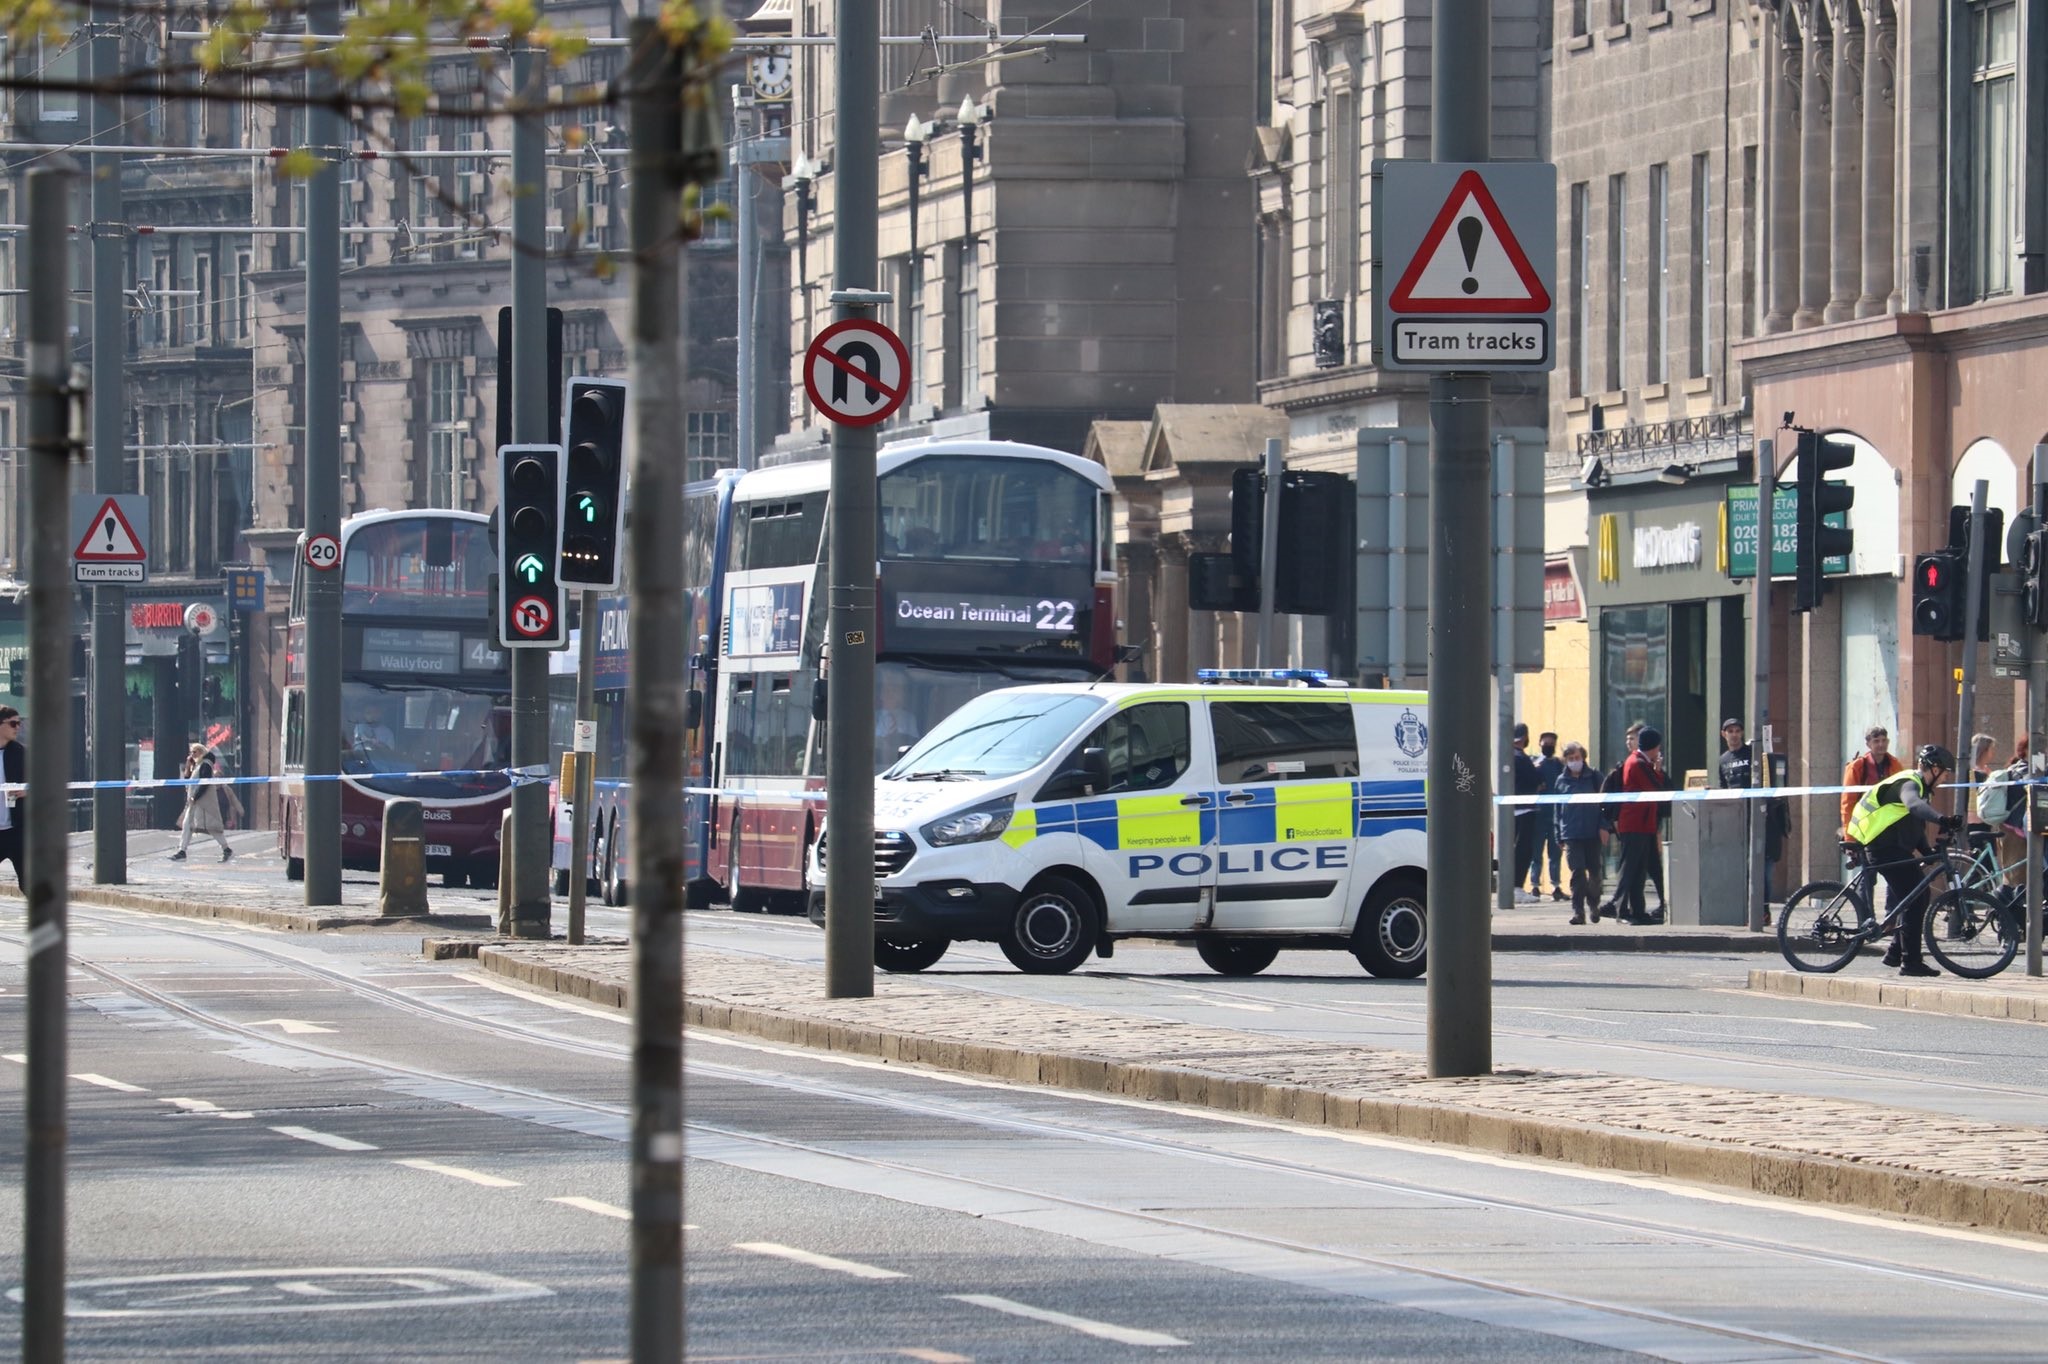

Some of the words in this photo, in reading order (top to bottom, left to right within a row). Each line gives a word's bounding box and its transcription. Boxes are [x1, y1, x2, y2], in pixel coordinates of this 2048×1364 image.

[1404, 331, 1460, 350] Tram
[1467, 331, 1536, 350] tracks
[1733, 500, 1758, 511] PRIM
[1773, 523, 1798, 537] 182
[311, 544, 336, 560] 20
[1734, 540, 1758, 554] 013
[80, 567, 106, 576] Tram
[108, 567, 140, 577] tracks
[898, 600, 954, 620] Ocean
[959, 602, 1032, 623] Terminal
[1036, 600, 1076, 630] 22
[380, 655, 443, 671] Wallyford
[423, 810, 452, 820] Buses
[1126, 836, 1154, 846] Keeping
[1155, 834, 1177, 844] people
[1178, 833, 1191, 843] safe
[1295, 828, 1342, 838] PoliceScotland
[1129, 846, 1348, 879] POLICE
